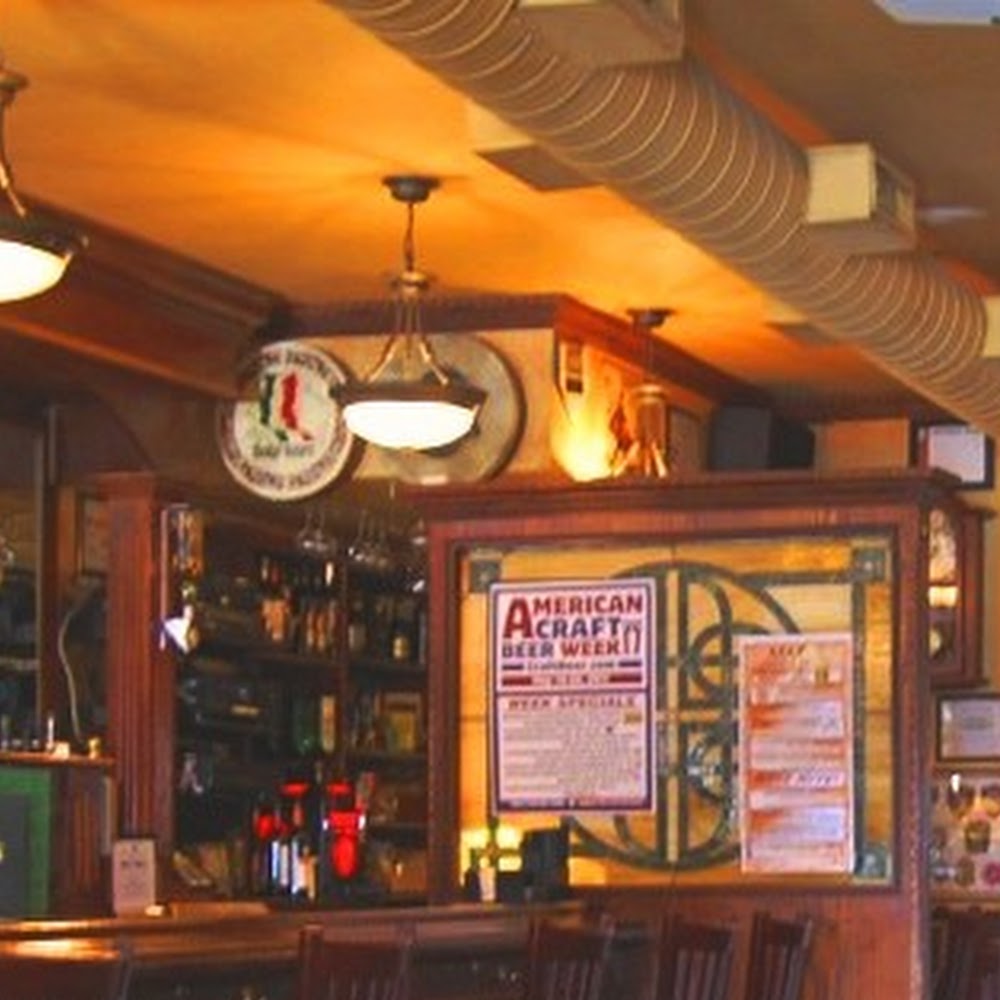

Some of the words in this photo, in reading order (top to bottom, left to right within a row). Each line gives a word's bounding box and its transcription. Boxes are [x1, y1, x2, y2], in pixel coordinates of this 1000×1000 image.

[503, 594, 643, 639] AMERICAN
[536, 617, 621, 639] CRAFT
[502, 640, 554, 659] BEER
[560, 638, 620, 658] WEEK
